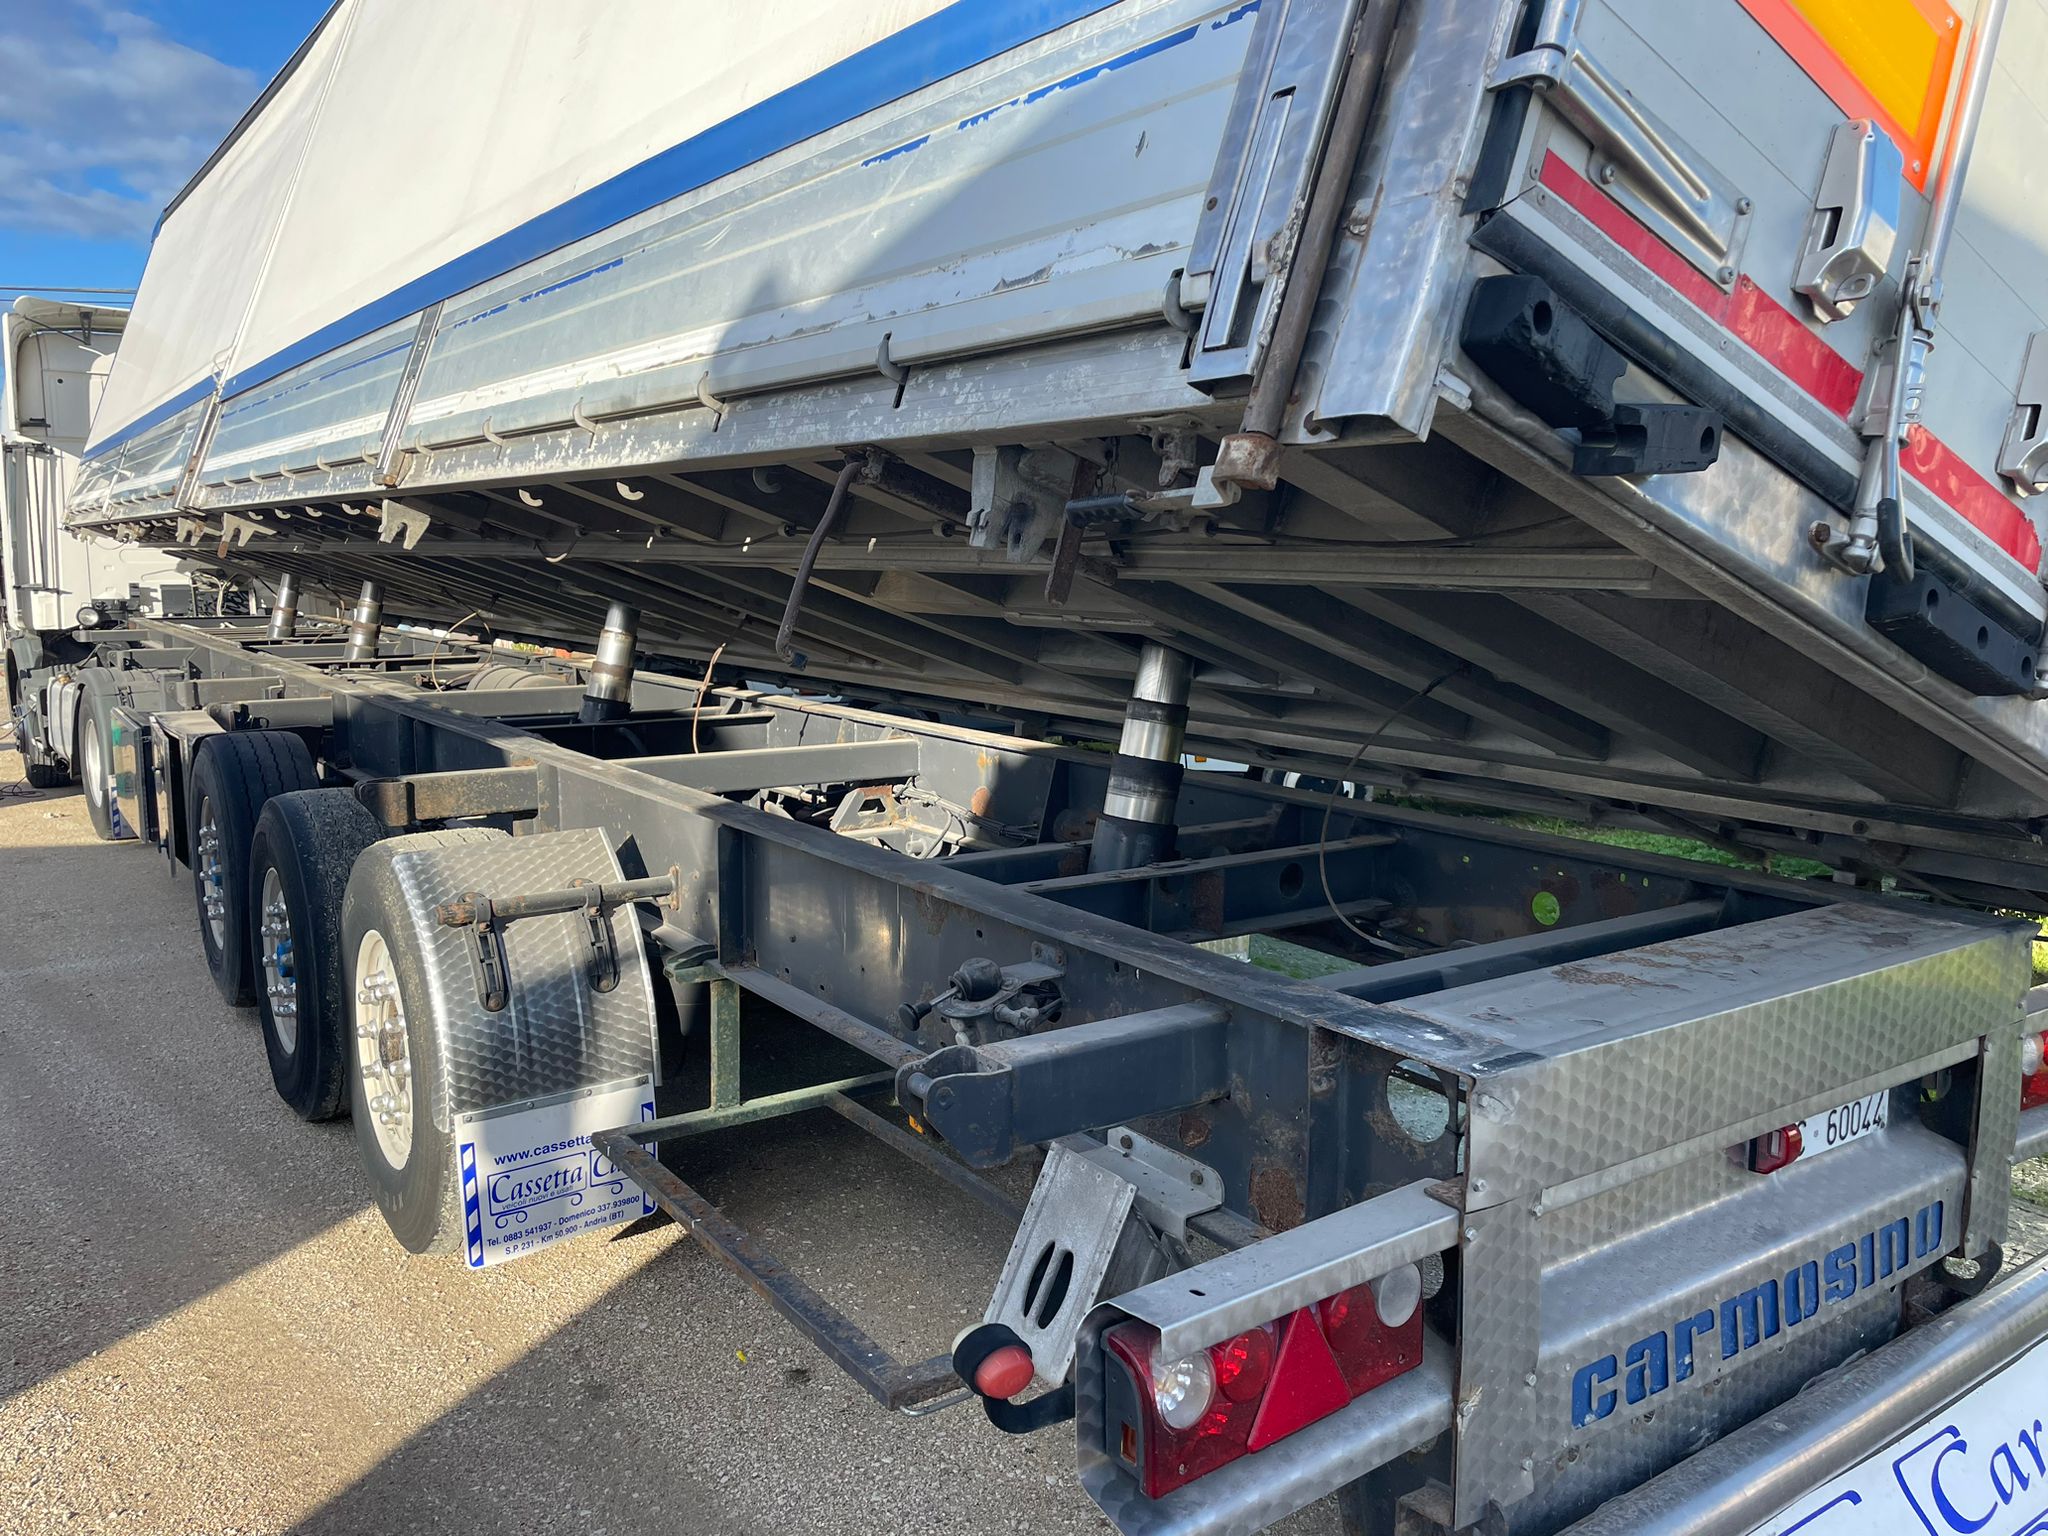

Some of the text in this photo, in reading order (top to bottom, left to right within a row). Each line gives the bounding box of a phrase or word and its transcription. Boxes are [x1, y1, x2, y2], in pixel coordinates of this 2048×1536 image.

[1827, 1091, 1884, 1145] 60044
[494, 1135, 592, 1166] www.cassetta
[491, 1166, 583, 1204] Cassetta
[528, 1193, 549, 1204] nuovi
[487, 1237, 502, 1247] Tel.
[503, 1230, 523, 1243] 0883
[524, 1221, 552, 1237] 541937
[558, 1208, 596, 1225] Domenico
[505, 1244, 519, 1255] S.P.
[521, 1239, 534, 1250] 231
[541, 1234, 554, 1244] Km
[584, 1215, 607, 1228] Andria
[608, 1209, 625, 1221] (BT)
[1571, 1200, 1944, 1430] carmosino
[1931, 1419, 2047, 1535] Car
